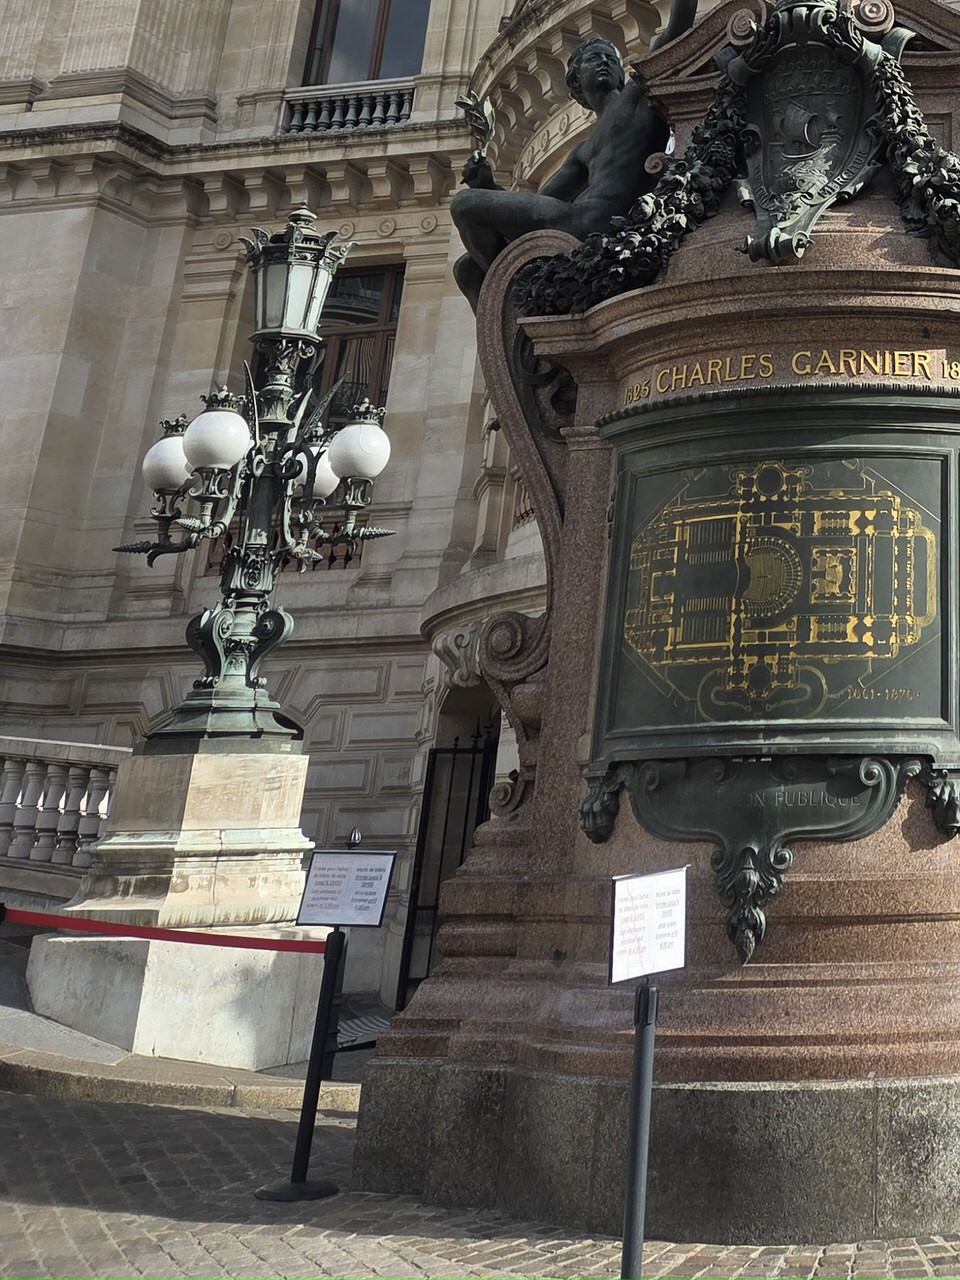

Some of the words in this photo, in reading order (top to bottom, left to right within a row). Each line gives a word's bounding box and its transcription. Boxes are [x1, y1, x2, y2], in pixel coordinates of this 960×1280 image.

[623, 378, 651, 406] 1825
[656, 352, 774, 394] CHARLES
[791, 348, 932, 381] GARNIER
[775, 789, 862, 808] PUBLIQUE
